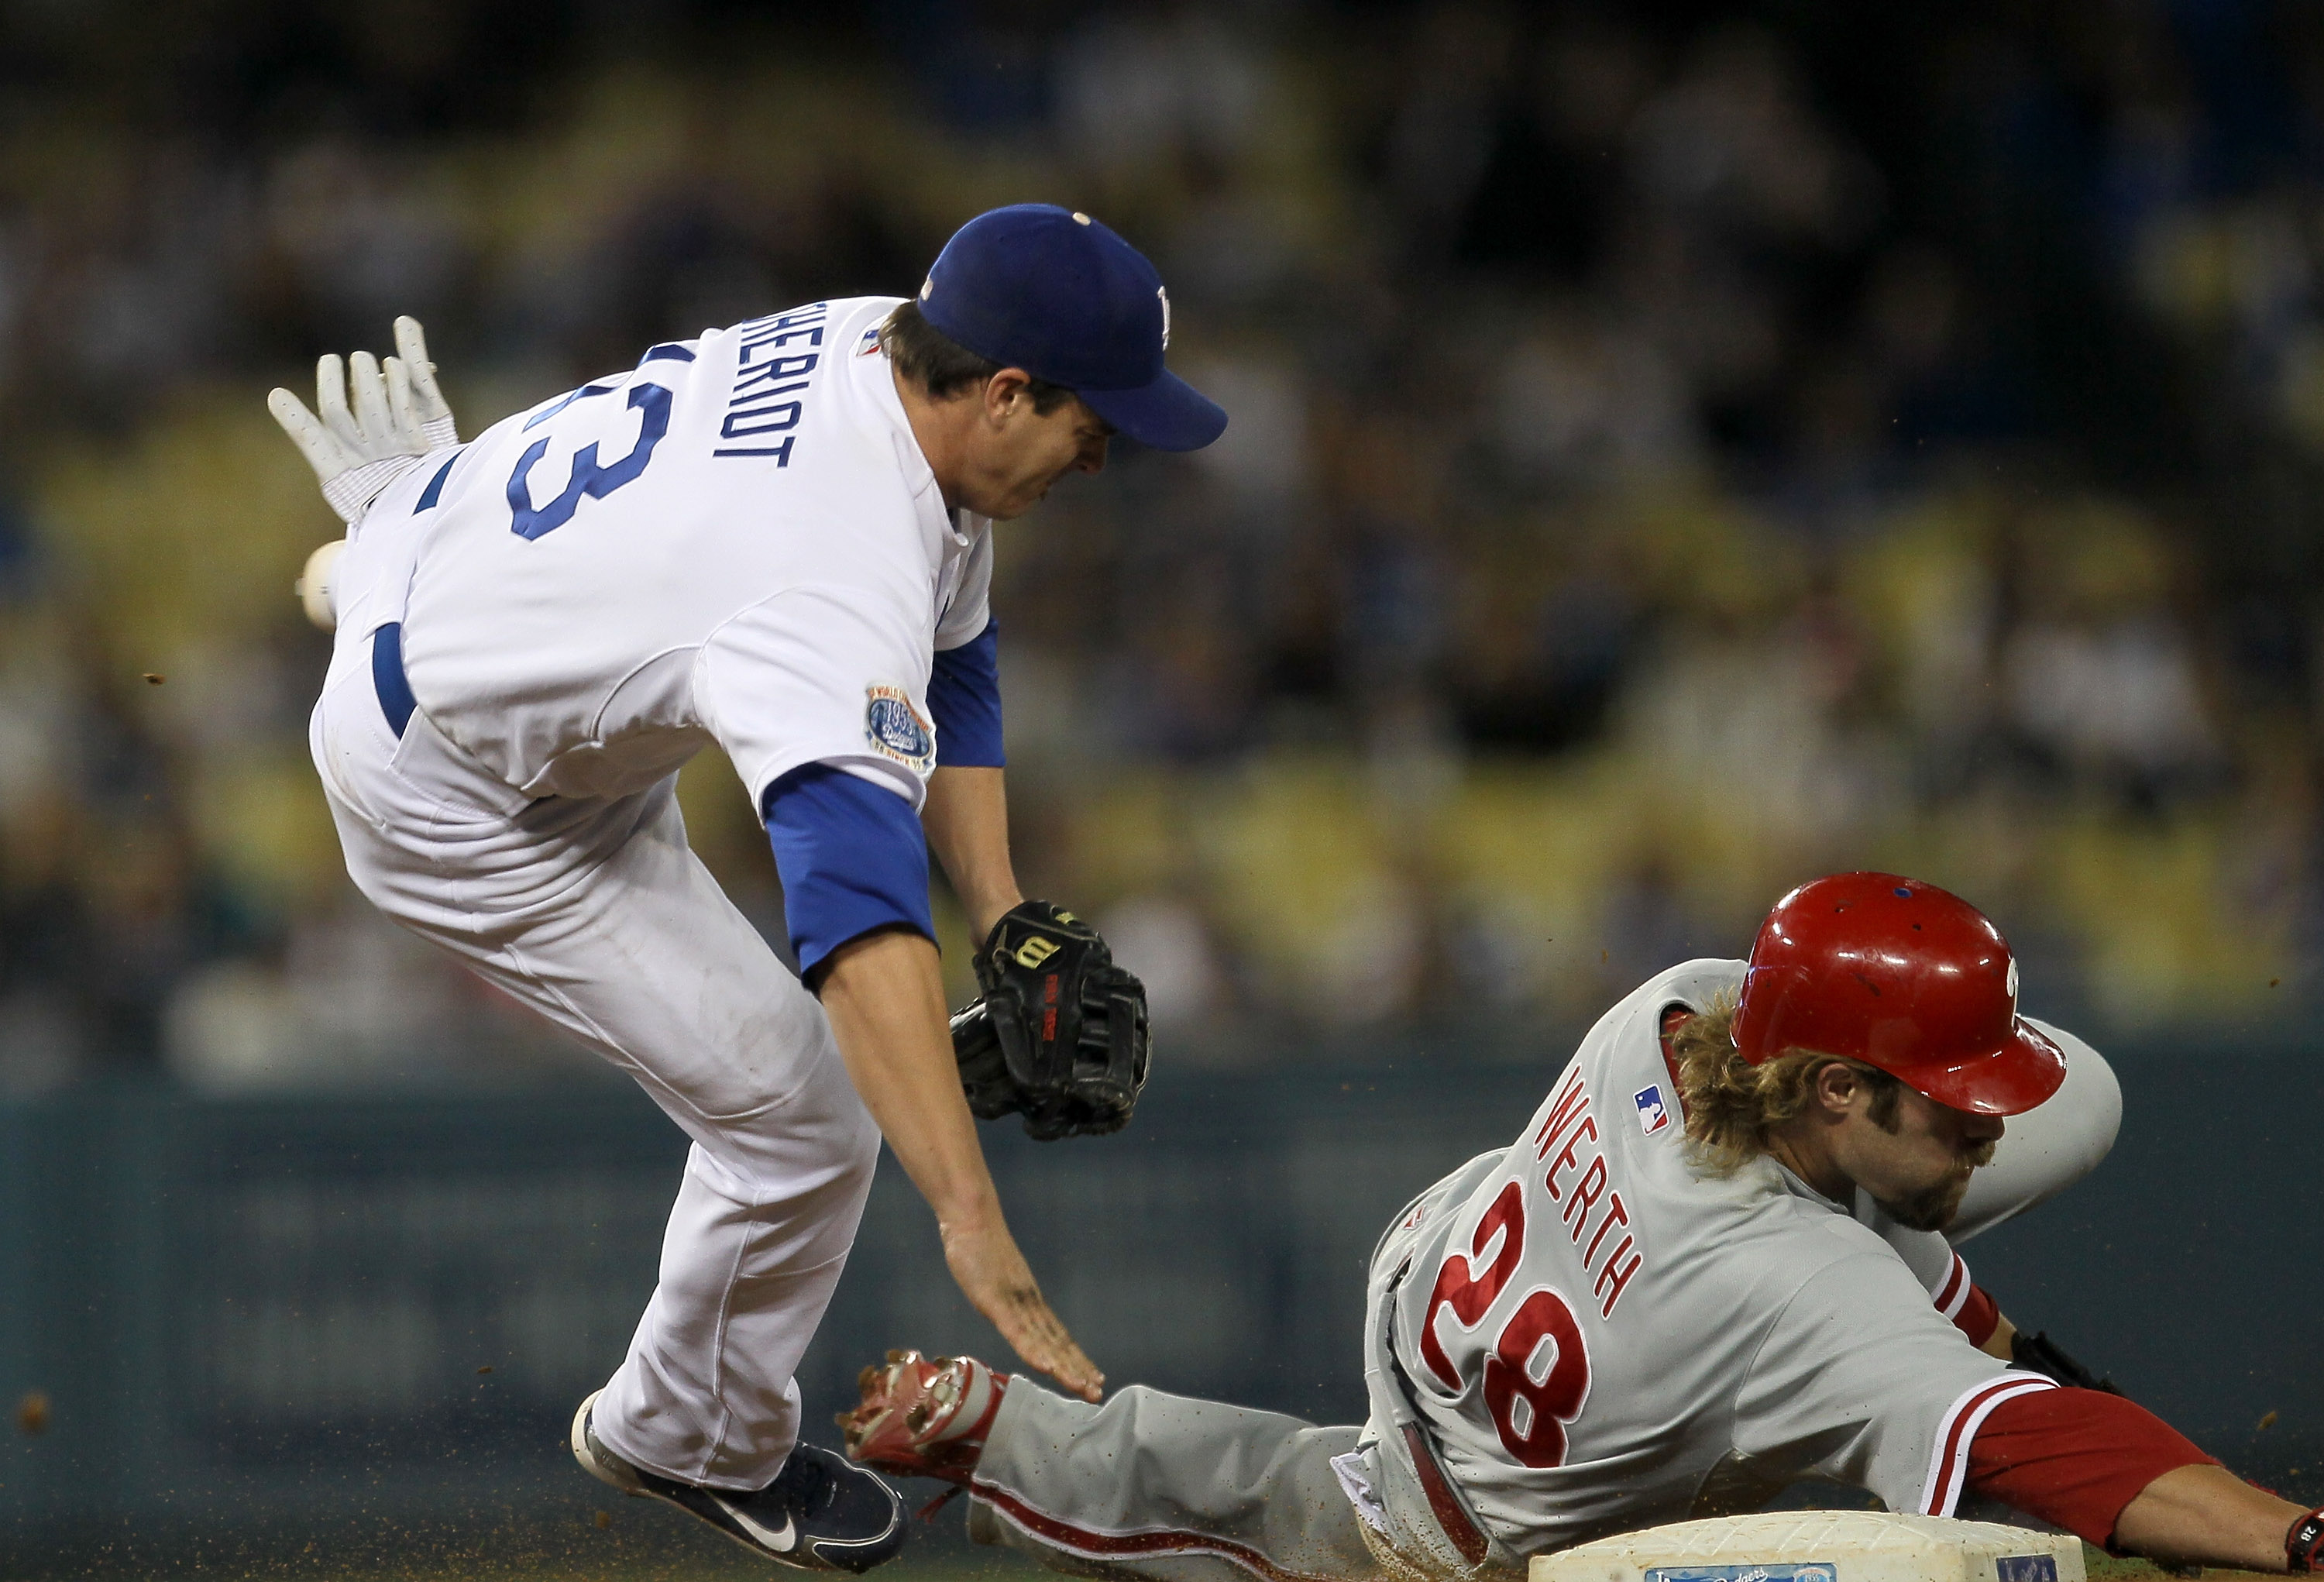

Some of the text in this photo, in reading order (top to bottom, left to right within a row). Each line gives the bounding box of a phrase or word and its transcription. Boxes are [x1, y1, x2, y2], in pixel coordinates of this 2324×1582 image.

[1534, 1064, 1643, 1319] WERTH
[1419, 1176, 1592, 1467] 28
[2301, 1525, 2317, 1542] 28
